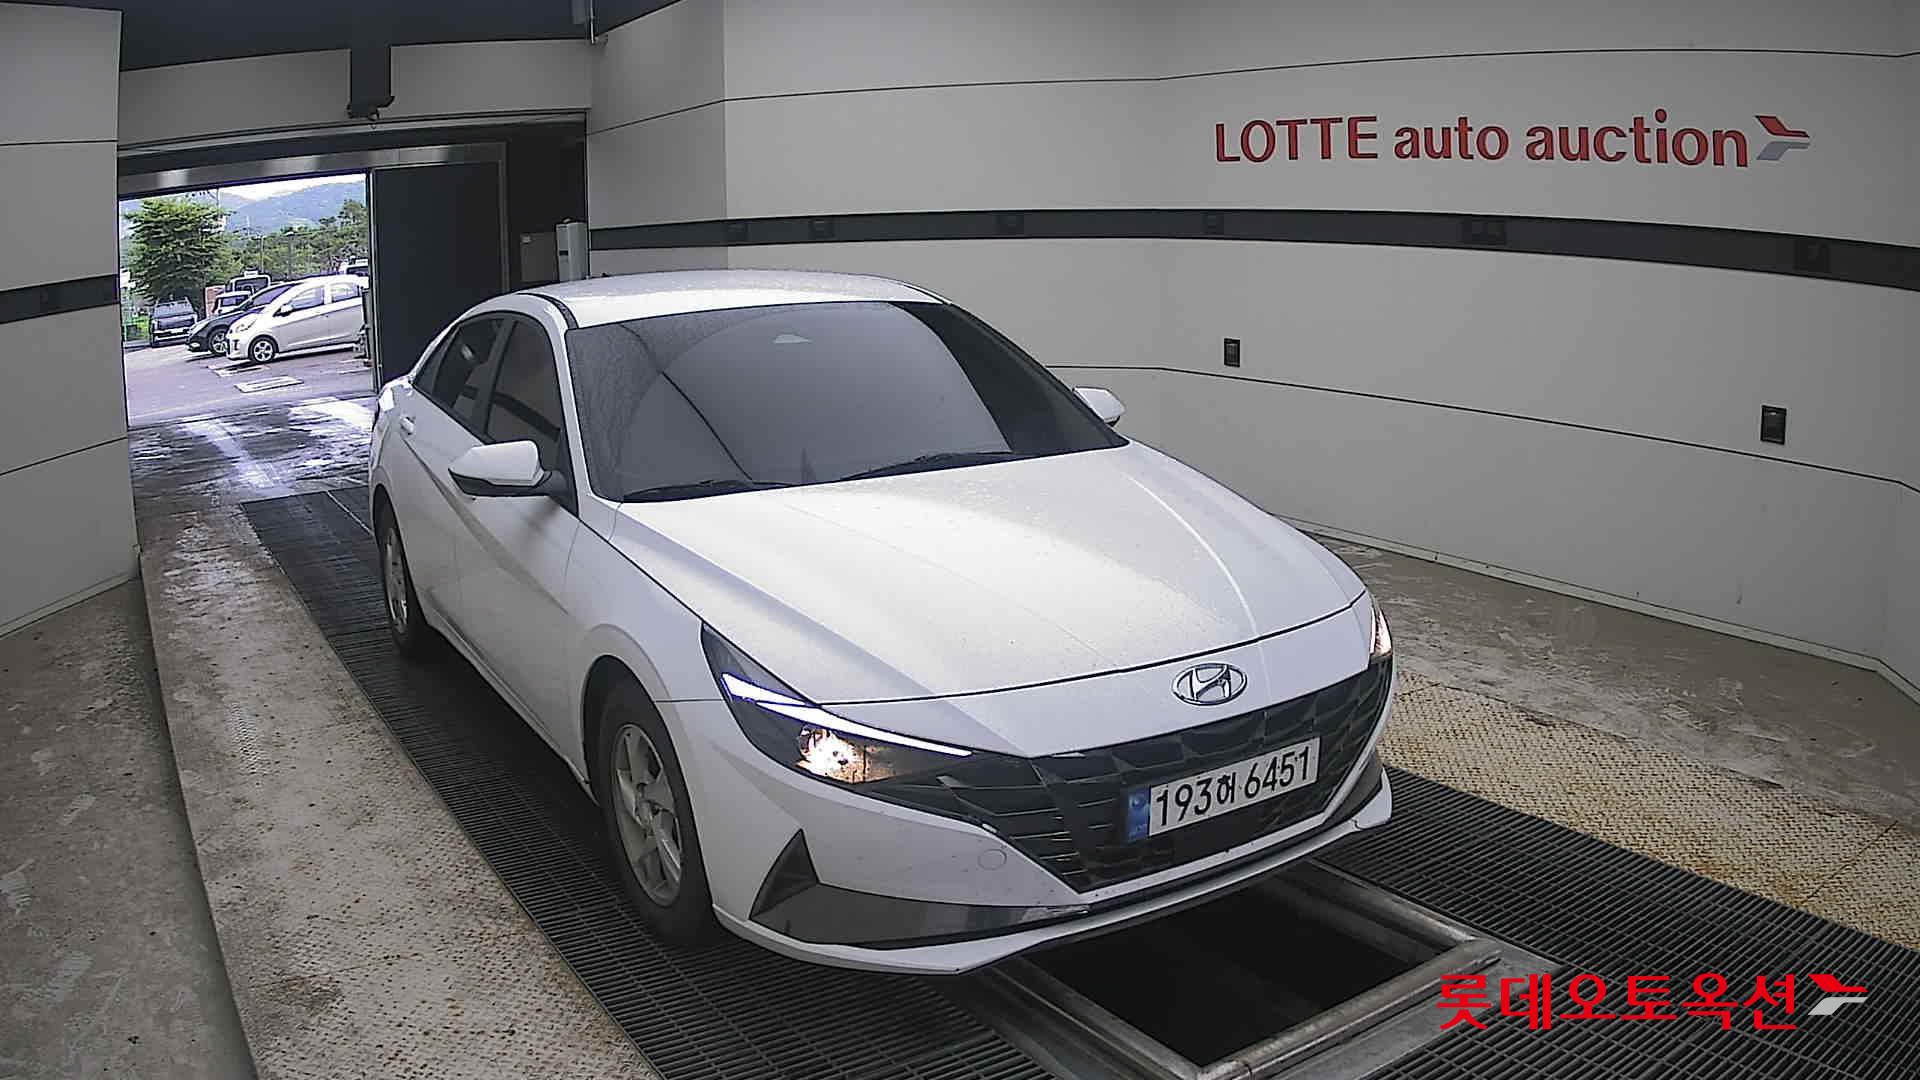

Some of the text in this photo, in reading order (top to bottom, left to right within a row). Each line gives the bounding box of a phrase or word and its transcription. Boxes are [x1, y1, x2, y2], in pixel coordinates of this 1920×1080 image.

[1215, 109, 1748, 167] LOTTE auto auction
[1156, 746, 1310, 826] 193허 6451
